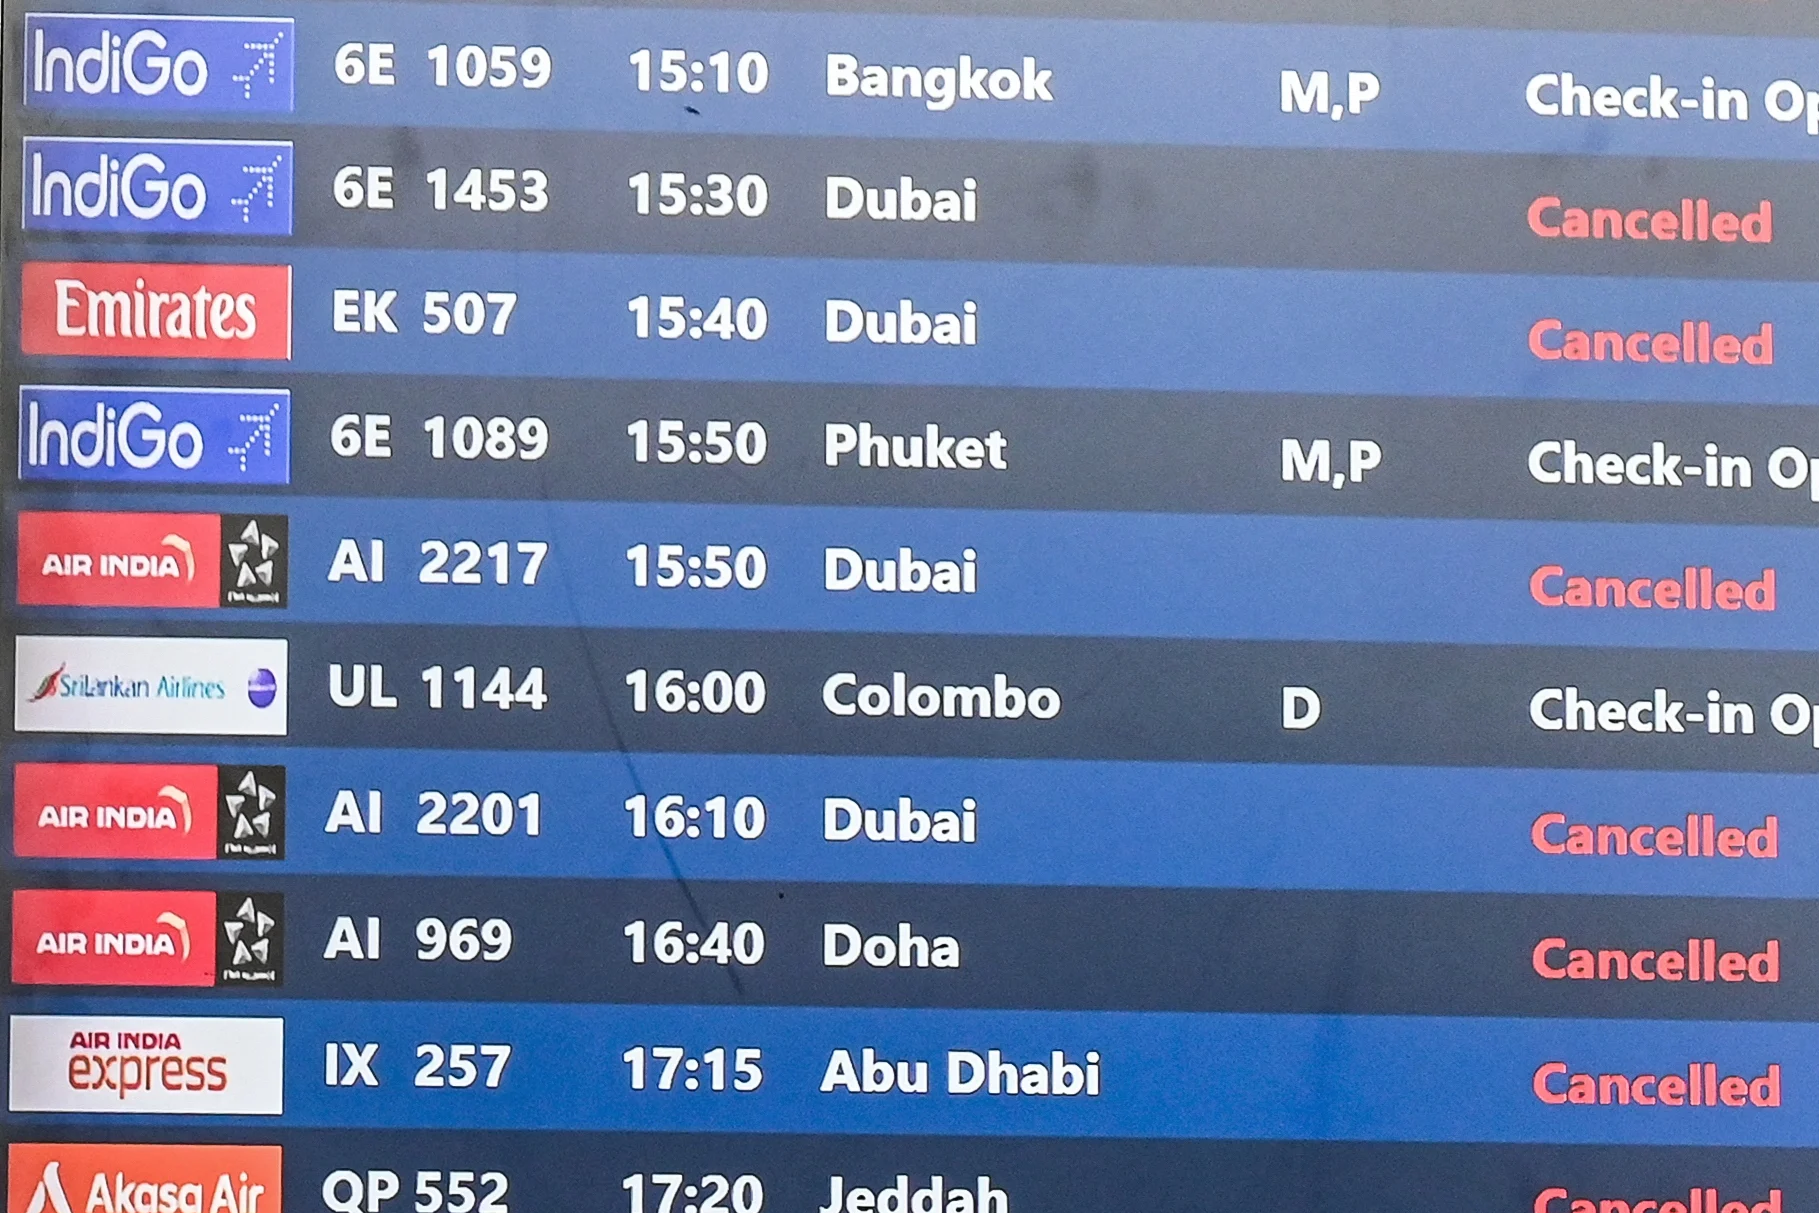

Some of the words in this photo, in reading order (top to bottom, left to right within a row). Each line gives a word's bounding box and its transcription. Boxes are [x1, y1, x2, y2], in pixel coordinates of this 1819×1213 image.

[34, 29, 208, 97] IndiGo
[335, 42, 395, 85] 6E
[427, 44, 551, 89] 1059
[629, 49, 769, 94] 15:10
[827, 53, 1054, 111] Bangkok
[1281, 70, 1380, 121] M,P
[1525, 72, 1748, 121] Check-in
[32, 152, 207, 220] IndiGo
[333, 166, 394, 209] 6E
[426, 167, 548, 212] 1453
[629, 172, 768, 217] 15:30
[826, 176, 977, 222] Dubai
[1527, 195, 1773, 243] Cancelled
[54, 278, 256, 339] Emirates
[333, 289, 398, 333] EK
[423, 291, 517, 335] 507
[628, 295, 768, 341] 15:40
[826, 299, 977, 345] Dubai
[1529, 318, 1773, 365] Cancelled
[28, 401, 204, 470] IndiGo
[330, 414, 392, 458] 6E
[424, 415, 549, 460] 1089
[627, 419, 767, 465] 15:50
[825, 422, 1007, 470] Phuket
[1282, 438, 1382, 490] M,P
[1528, 439, 1752, 488] Check-in
[42, 554, 93, 576] AIR
[100, 554, 180, 577] INDIA
[327, 538, 384, 582] AI
[419, 540, 548, 585] 2217
[626, 544, 767, 589] 15:50
[825, 547, 977, 593] Dubai
[1530, 565, 1776, 611] Cancelled
[59, 673, 150, 699] SriLankan
[156, 675, 226, 700] Airlines
[329, 663, 398, 708] UL
[421, 665, 548, 710] 1144
[625, 669, 766, 714] 16:00
[822, 671, 1061, 719] Colombo
[1282, 686, 1321, 729] D
[1529, 686, 1754, 734] Check-in
[38, 805, 89, 828] AIR
[97, 806, 177, 829] INDIA
[324, 789, 381, 834] AI
[416, 791, 540, 836] 2201
[625, 794, 766, 839] 16:10
[824, 797, 976, 843] Dubai
[1532, 812, 1778, 858] Cancelled
[36, 932, 87, 955] AIR
[95, 933, 175, 955] INDIA
[323, 916, 380, 960] AI
[415, 917, 512, 961] 969
[624, 920, 765, 965] 16:40
[823, 922, 960, 968] Doha
[1532, 937, 1781, 983] Cancelled
[69, 1031, 111, 1050] AIR
[117, 1031, 182, 1051] INDIA
[325, 1042, 379, 1086] IX
[414, 1043, 511, 1088] 257
[623, 1046, 763, 1091] 17:15
[819, 1047, 928, 1093] Abu
[947, 1049, 1100, 1096] Dhabi
[1533, 1062, 1781, 1107] Cancelled
[67, 1053, 229, 1101] express
